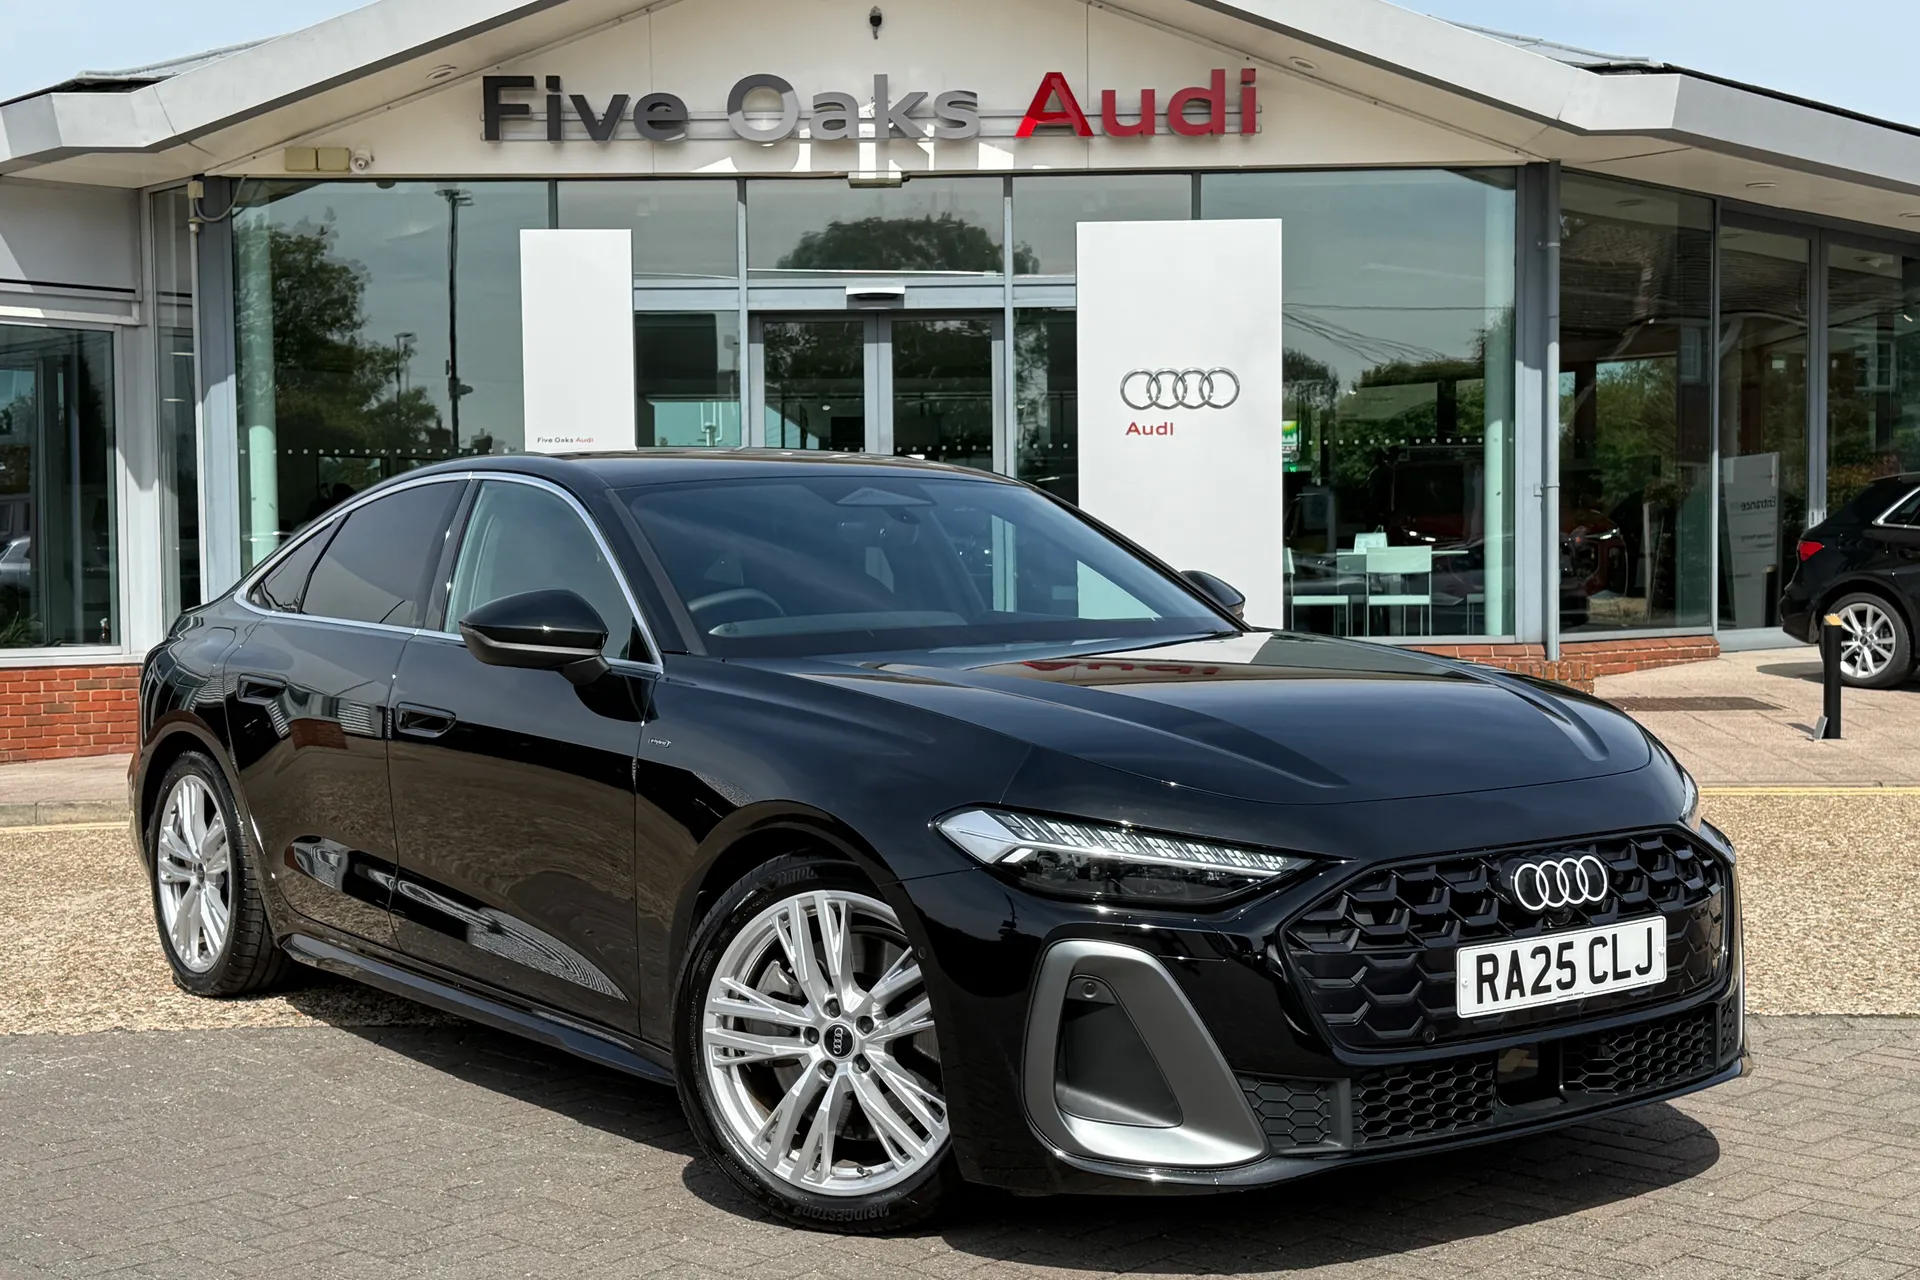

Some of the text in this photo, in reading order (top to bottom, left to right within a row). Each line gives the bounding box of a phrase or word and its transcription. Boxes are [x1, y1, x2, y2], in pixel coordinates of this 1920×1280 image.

[483, 68, 1257, 143] Five Oaks Audi
[1125, 421, 1174, 436] Audi
[1475, 926, 1653, 1004] RA25 CLJ
